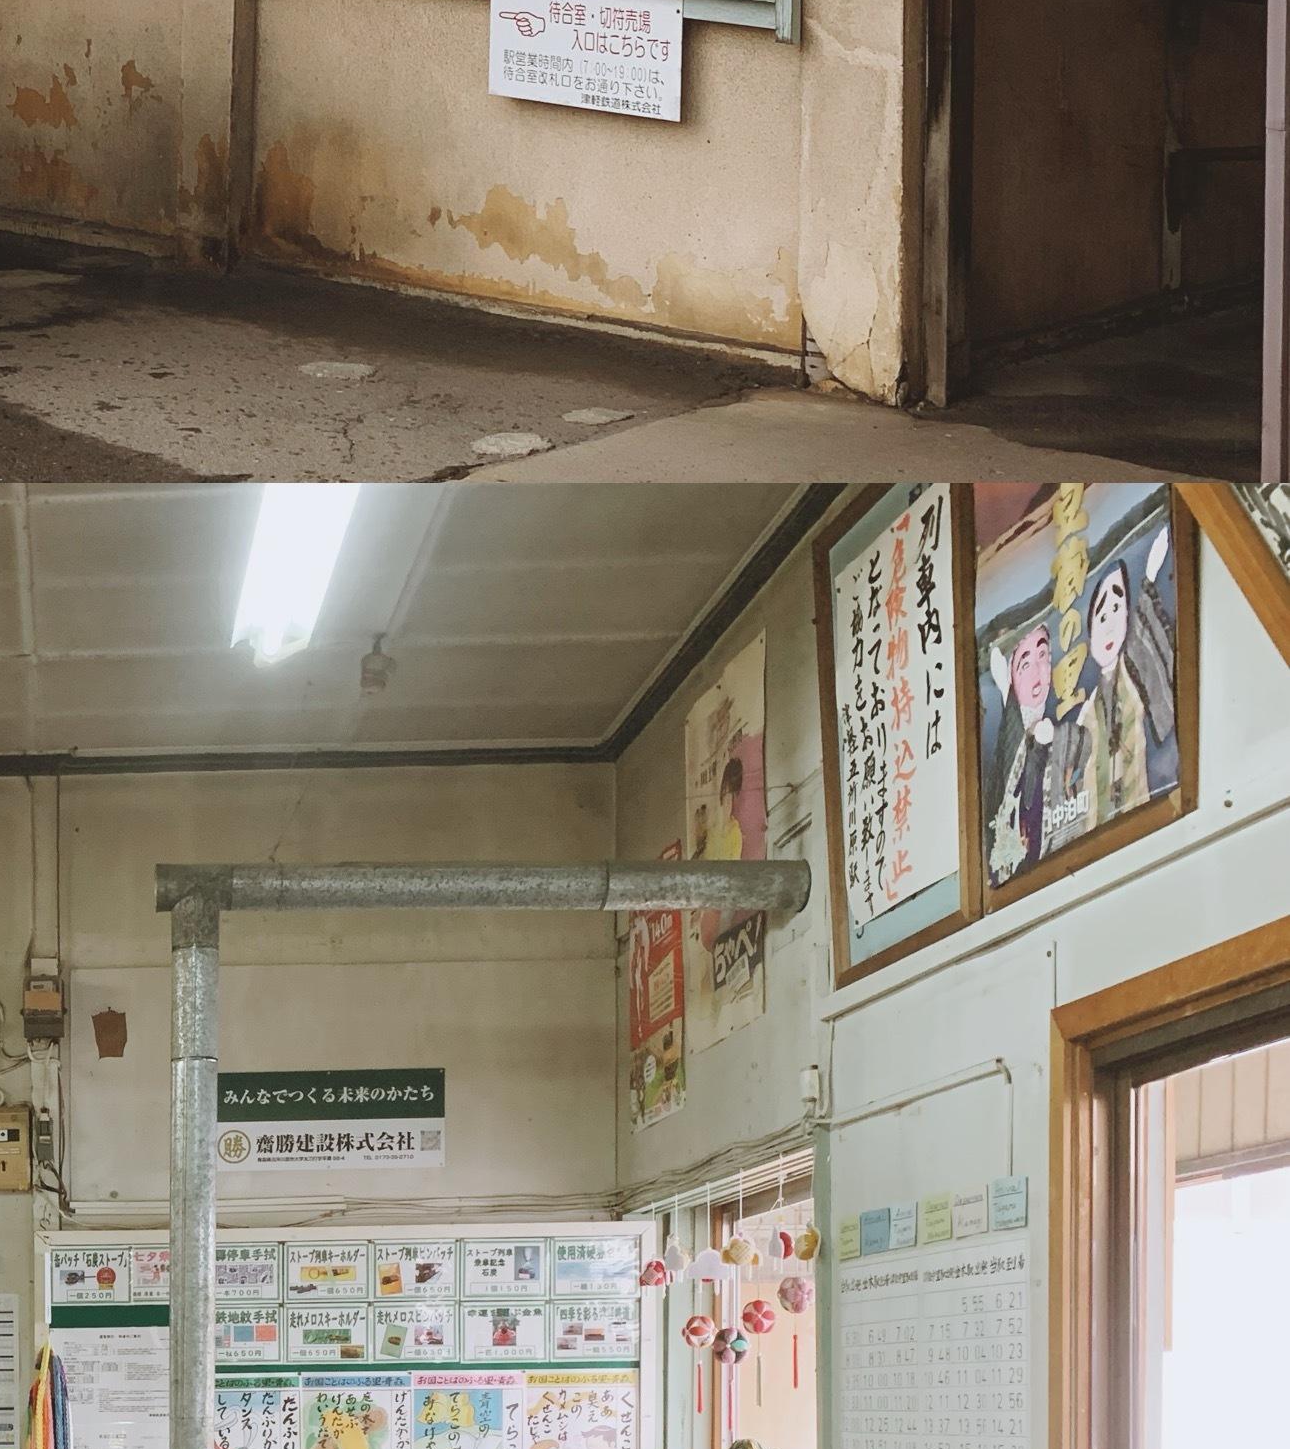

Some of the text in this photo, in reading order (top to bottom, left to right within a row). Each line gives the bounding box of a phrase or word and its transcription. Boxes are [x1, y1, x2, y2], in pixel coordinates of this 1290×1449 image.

[549, 1, 651, 34] 待合室・切符売場
[571, 29, 671, 62] 入口はこちらです
[504, 66, 662, 101] 待合室改札口をお通り下さい。
[581, 93, 662, 115] 津軽鉄道株式会社
[916, 495, 944, 760] 列車内には
[868, 550, 888, 891] となっておりますので
[224, 1085, 435, 1105] みんなでつくる未来のかたち
[224, 1135, 247, 1159] 勝
[466, 1249, 513, 1257] ストーブ列車
[482, 1269, 497, 1277] 石炭
[571, 1393, 582, 1420] この
